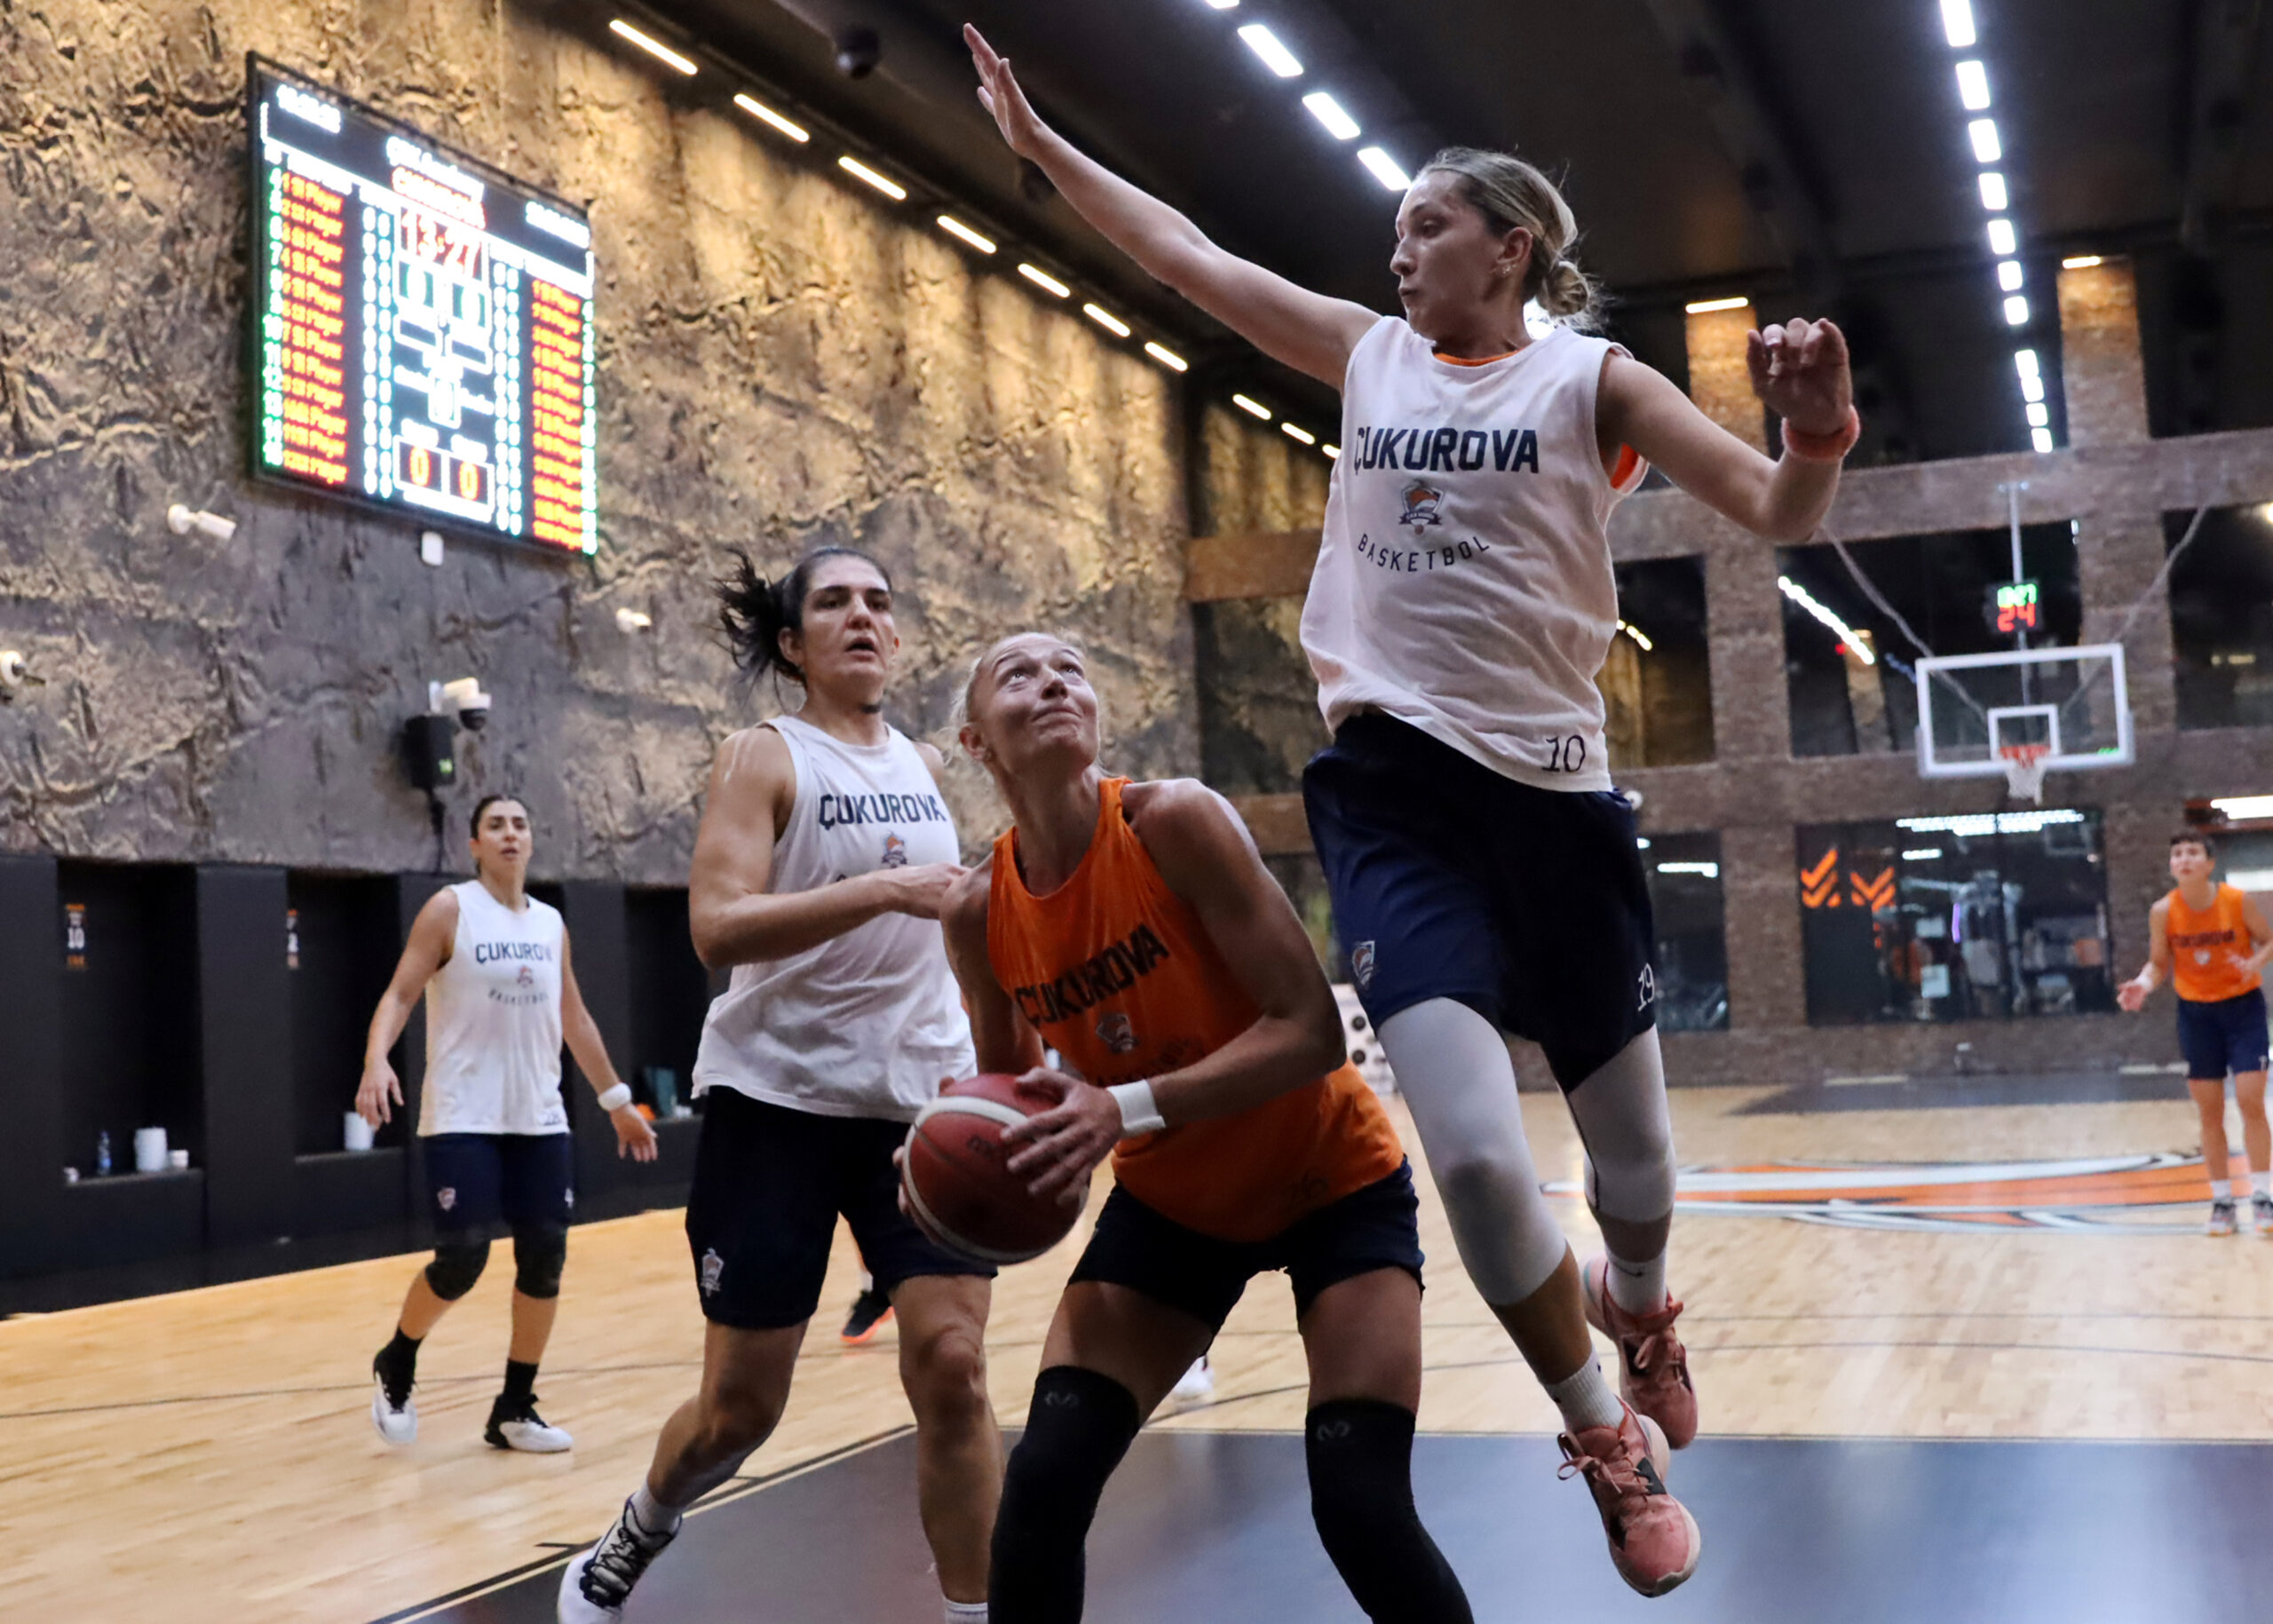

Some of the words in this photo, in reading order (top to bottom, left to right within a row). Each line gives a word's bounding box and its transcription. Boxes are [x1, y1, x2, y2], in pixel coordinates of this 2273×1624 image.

[409, 445, 431, 487] 0
[459, 461, 479, 502] 0
[1353, 426, 1540, 477] ÇUKUROVA
[1357, 533, 1491, 573] BASKETBOL
[1996, 603, 2036, 632] 24
[1541, 733, 1587, 773] 10
[818, 793, 947, 831] ÇUKUROVA
[1014, 922, 1170, 1030] ÇUKUROVA
[1637, 963, 1656, 1012] 19
